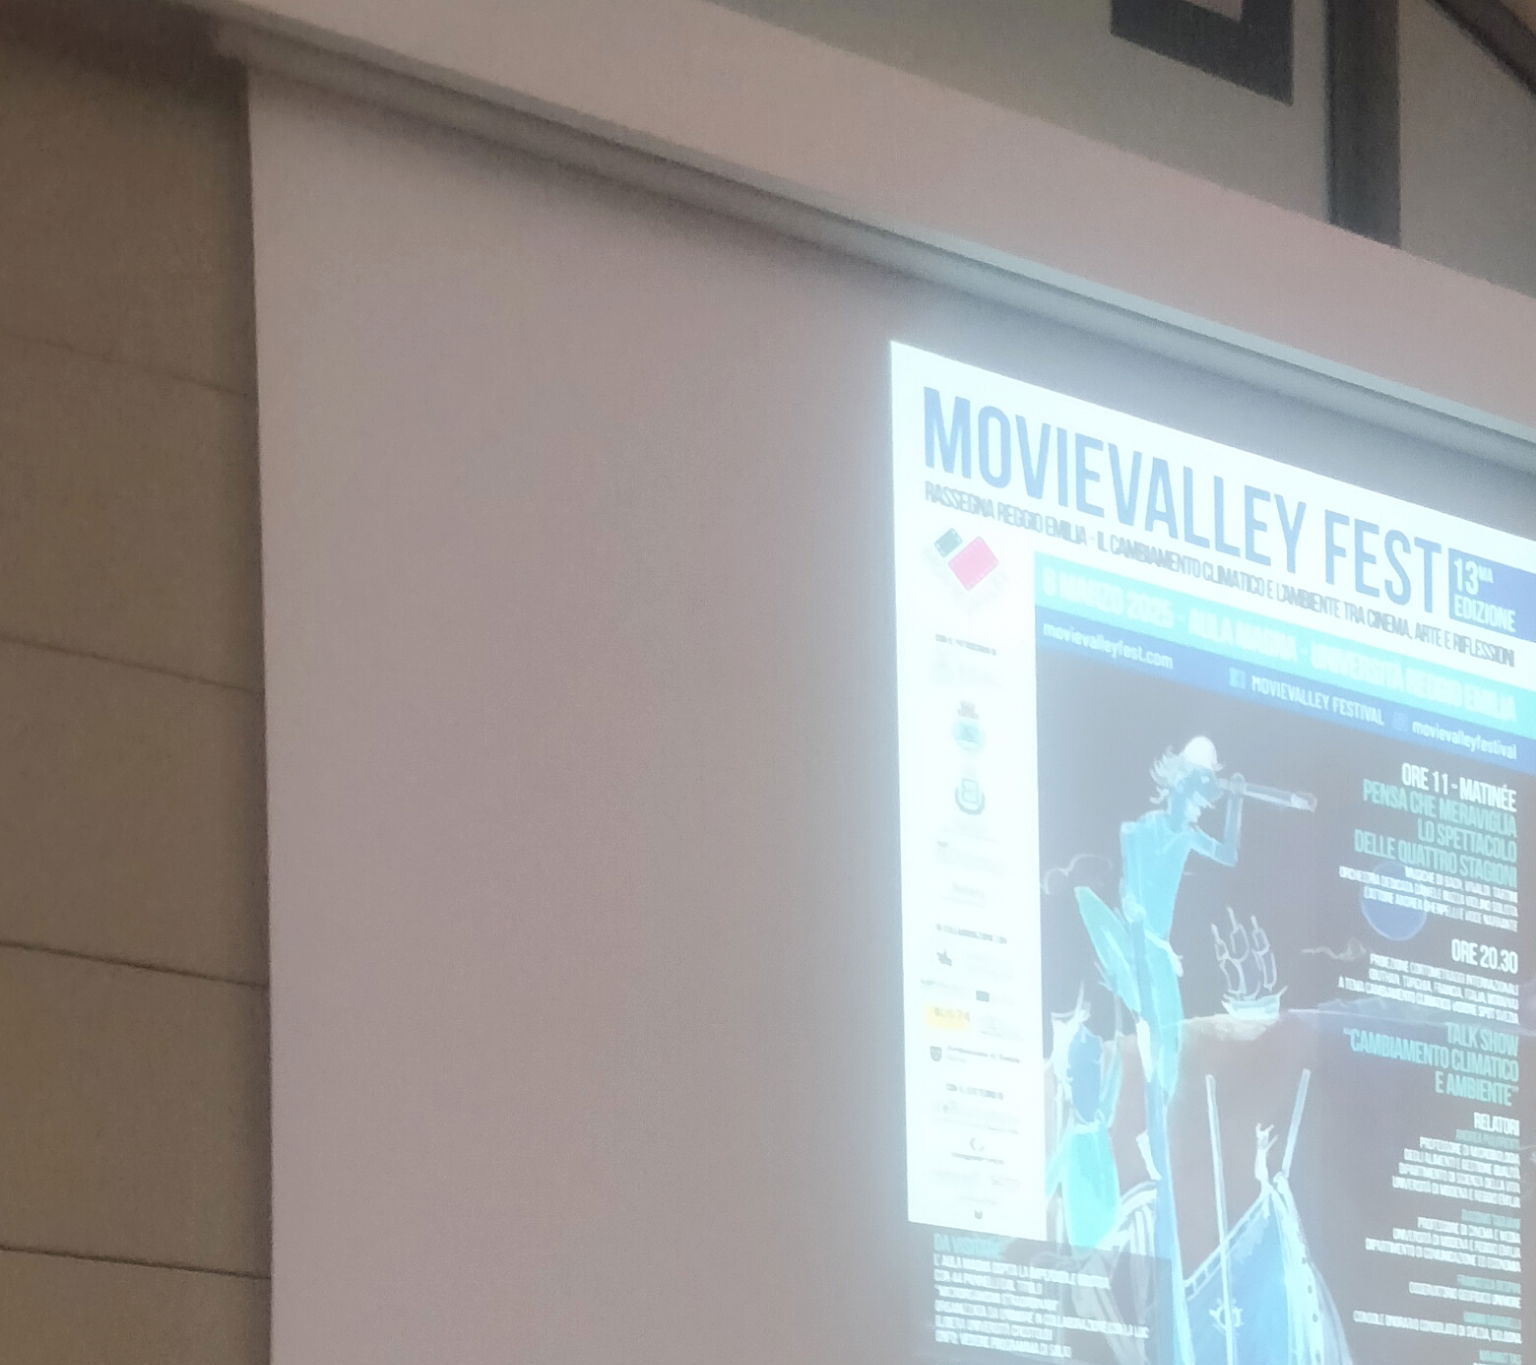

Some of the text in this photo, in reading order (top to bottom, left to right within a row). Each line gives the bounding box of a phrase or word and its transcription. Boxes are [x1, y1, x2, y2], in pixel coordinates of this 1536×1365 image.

[923, 386, 1441, 613] MOVIEVALLEY FEST
[1344, 600, 1365, 625] TRA
[1454, 597, 1517, 632] EDIZIONE
[1043, 622, 1174, 670] movievalleyfest.com
[1251, 674, 1384, 727] MOVIEVALLEY FESTIVAL
[1412, 721, 1517, 760] movievalleyfestival
[1363, 779, 1408, 811] PENSA
[1409, 791, 1437, 818] CHE
[1402, 763, 1429, 790] ORE
[1431, 772, 1449, 796] 11
[1353, 828, 1396, 861] DELLE
[1397, 838, 1458, 875] QUATTRO
[1417, 817, 1518, 864] LO SPETTACOLO
[1451, 939, 1478, 966] ORE
[1479, 946, 1519, 975] 20.30
[1435, 1071, 1444, 1094] E
[1450, 1047, 1519, 1083] CLIMATICO
